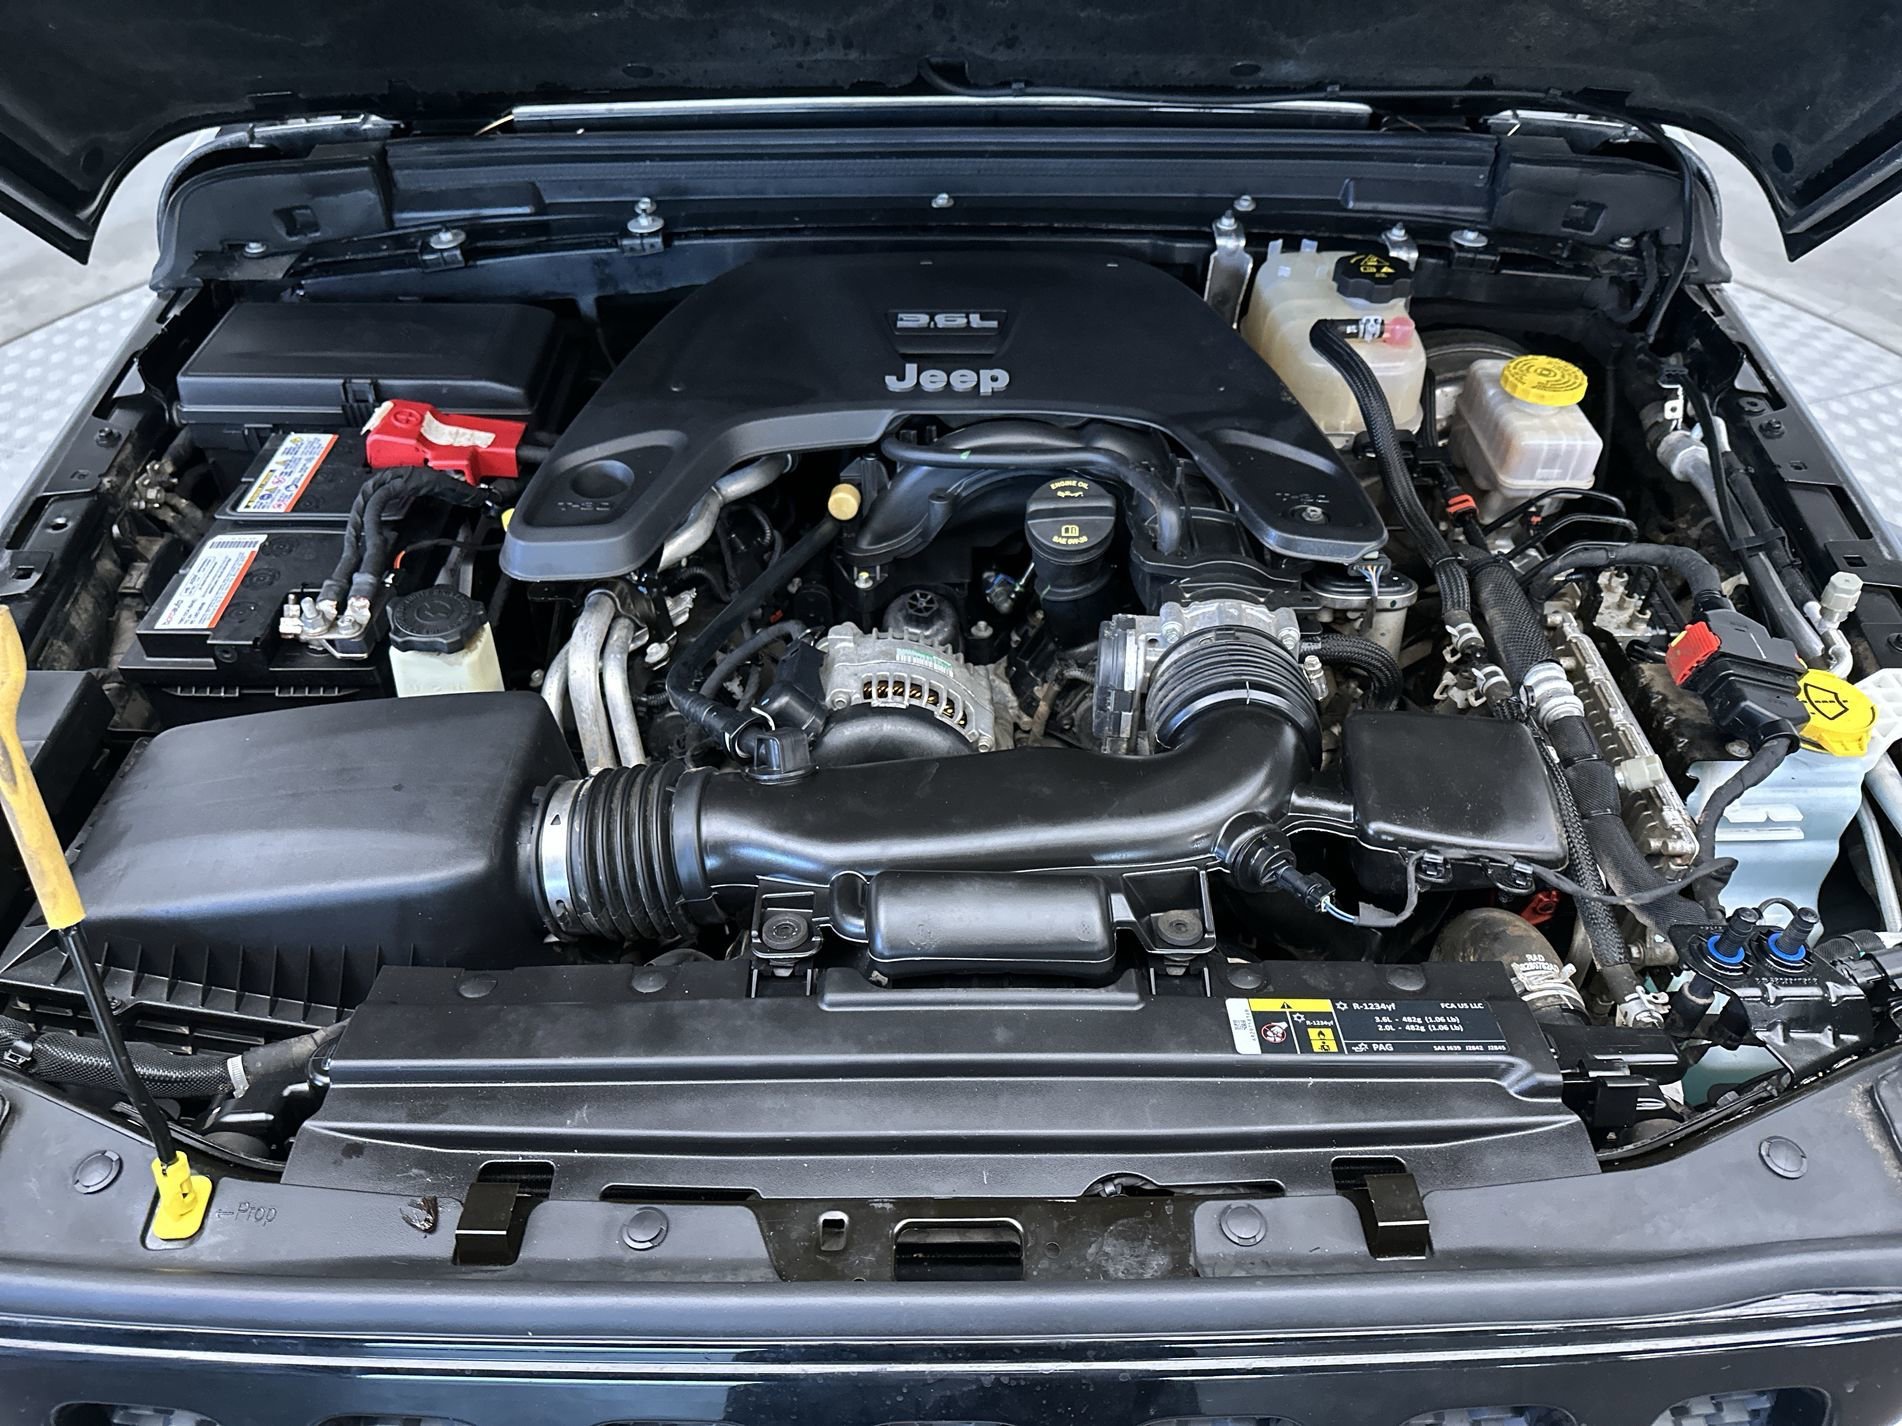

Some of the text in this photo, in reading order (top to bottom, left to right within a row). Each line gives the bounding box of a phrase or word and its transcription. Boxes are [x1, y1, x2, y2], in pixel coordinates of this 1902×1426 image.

[896, 313, 999, 328] 3.6L
[884, 363, 1010, 396] Jeep
[1050, 480, 1089, 490] ENGINE OIL
[1352, 1002, 1396, 1011] R-1234yf
[1402, 1016, 1423, 1024] 482g
[1424, 1016, 1446, 1024] (1.06
[1446, 1016, 1460, 1024] Lb)
[1377, 1024, 1396, 1032] 2.0L
[1405, 1024, 1426, 1032] 482g
[1428, 1024, 1449, 1032] (1.06
[1449, 1024, 1464, 1032] Lb)
[1372, 1043, 1394, 1051] PAG
[235, 1201, 277, 1227] Prop
